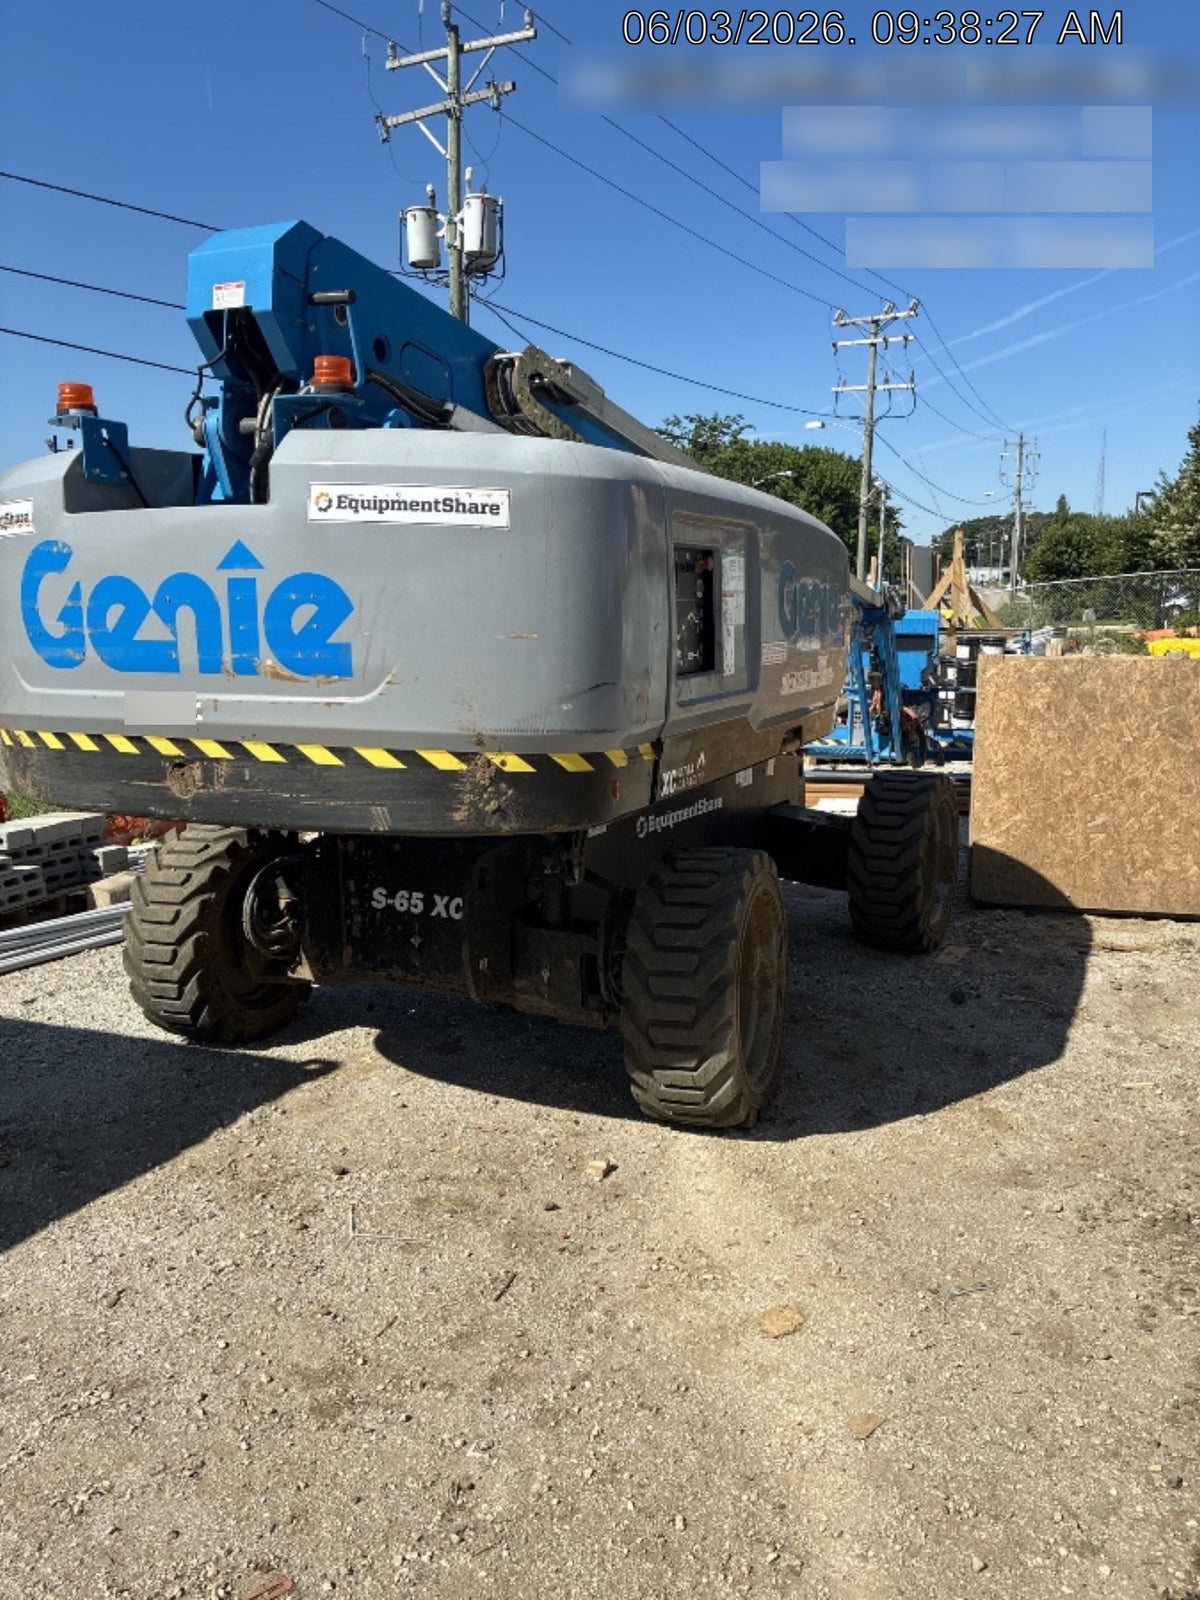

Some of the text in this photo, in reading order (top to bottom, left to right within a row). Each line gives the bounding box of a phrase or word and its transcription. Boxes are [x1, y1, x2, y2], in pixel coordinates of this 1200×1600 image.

[335, 494, 501, 516] EquipmentShare
[20, 539, 355, 678] Genie
[648, 797, 723, 832] EquipmentShare
[371, 886, 463, 919] S-65 XC
